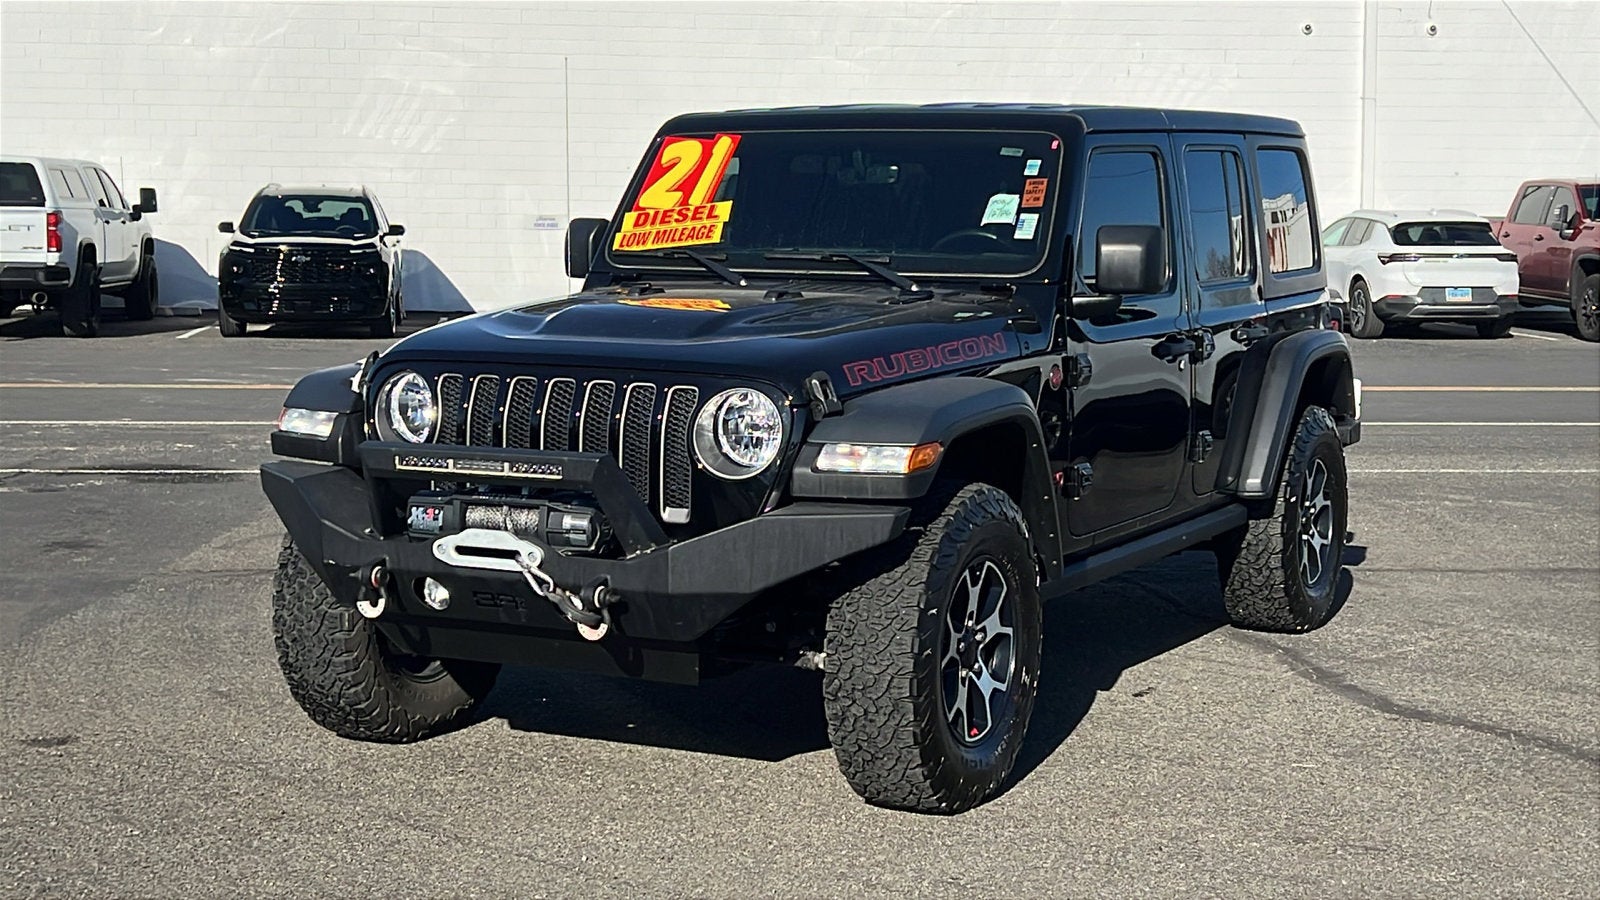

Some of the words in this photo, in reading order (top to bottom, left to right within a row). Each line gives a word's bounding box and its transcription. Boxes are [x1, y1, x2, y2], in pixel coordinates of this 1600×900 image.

[638, 136, 732, 209] 21
[618, 230, 652, 249] LOW
[652, 224, 716, 245] MILEAGE
[632, 203, 720, 230] DIESEL
[842, 332, 1007, 386] RUBICON
